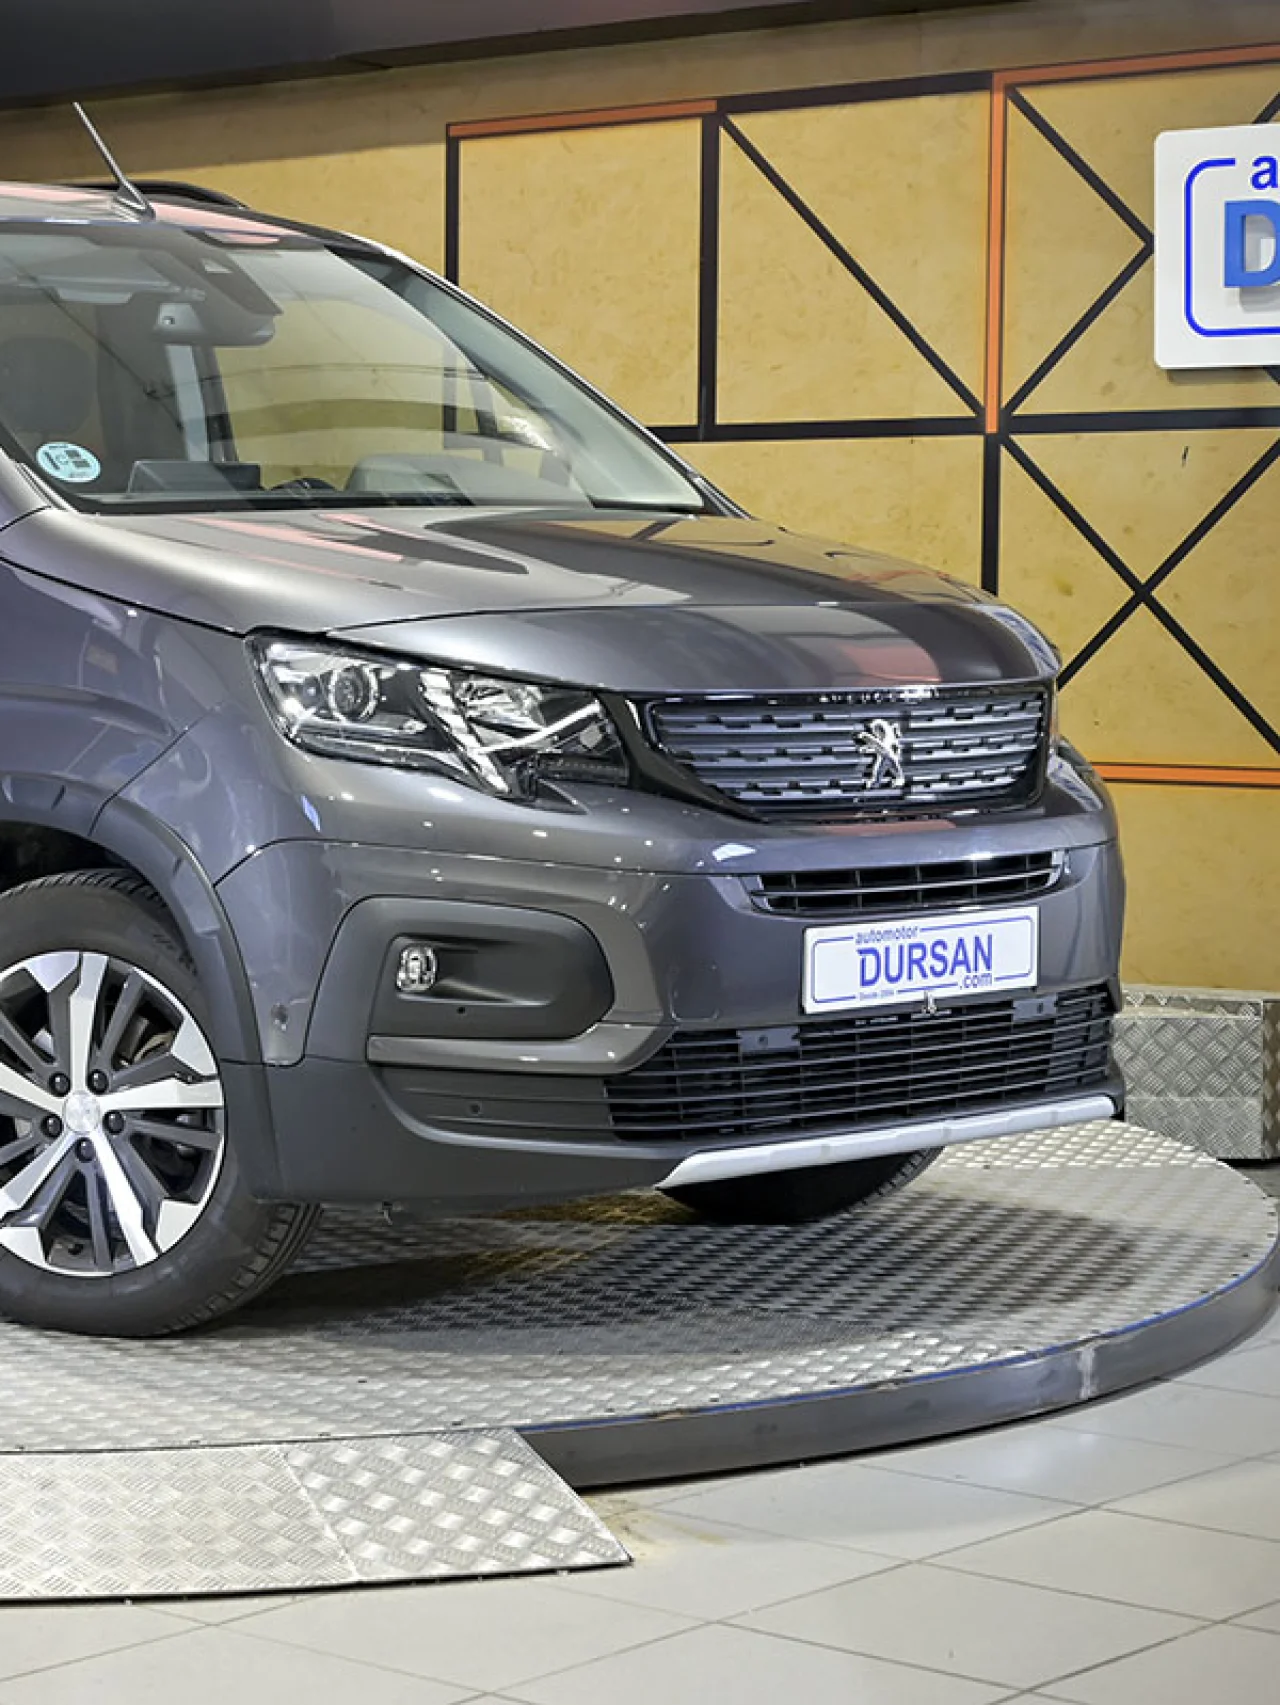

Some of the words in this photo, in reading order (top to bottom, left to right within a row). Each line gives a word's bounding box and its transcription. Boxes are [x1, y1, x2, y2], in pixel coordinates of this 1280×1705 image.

[856, 926, 918, 944] automotor
[857, 934, 993, 987] DURSAN
[960, 973, 993, 990] .com
